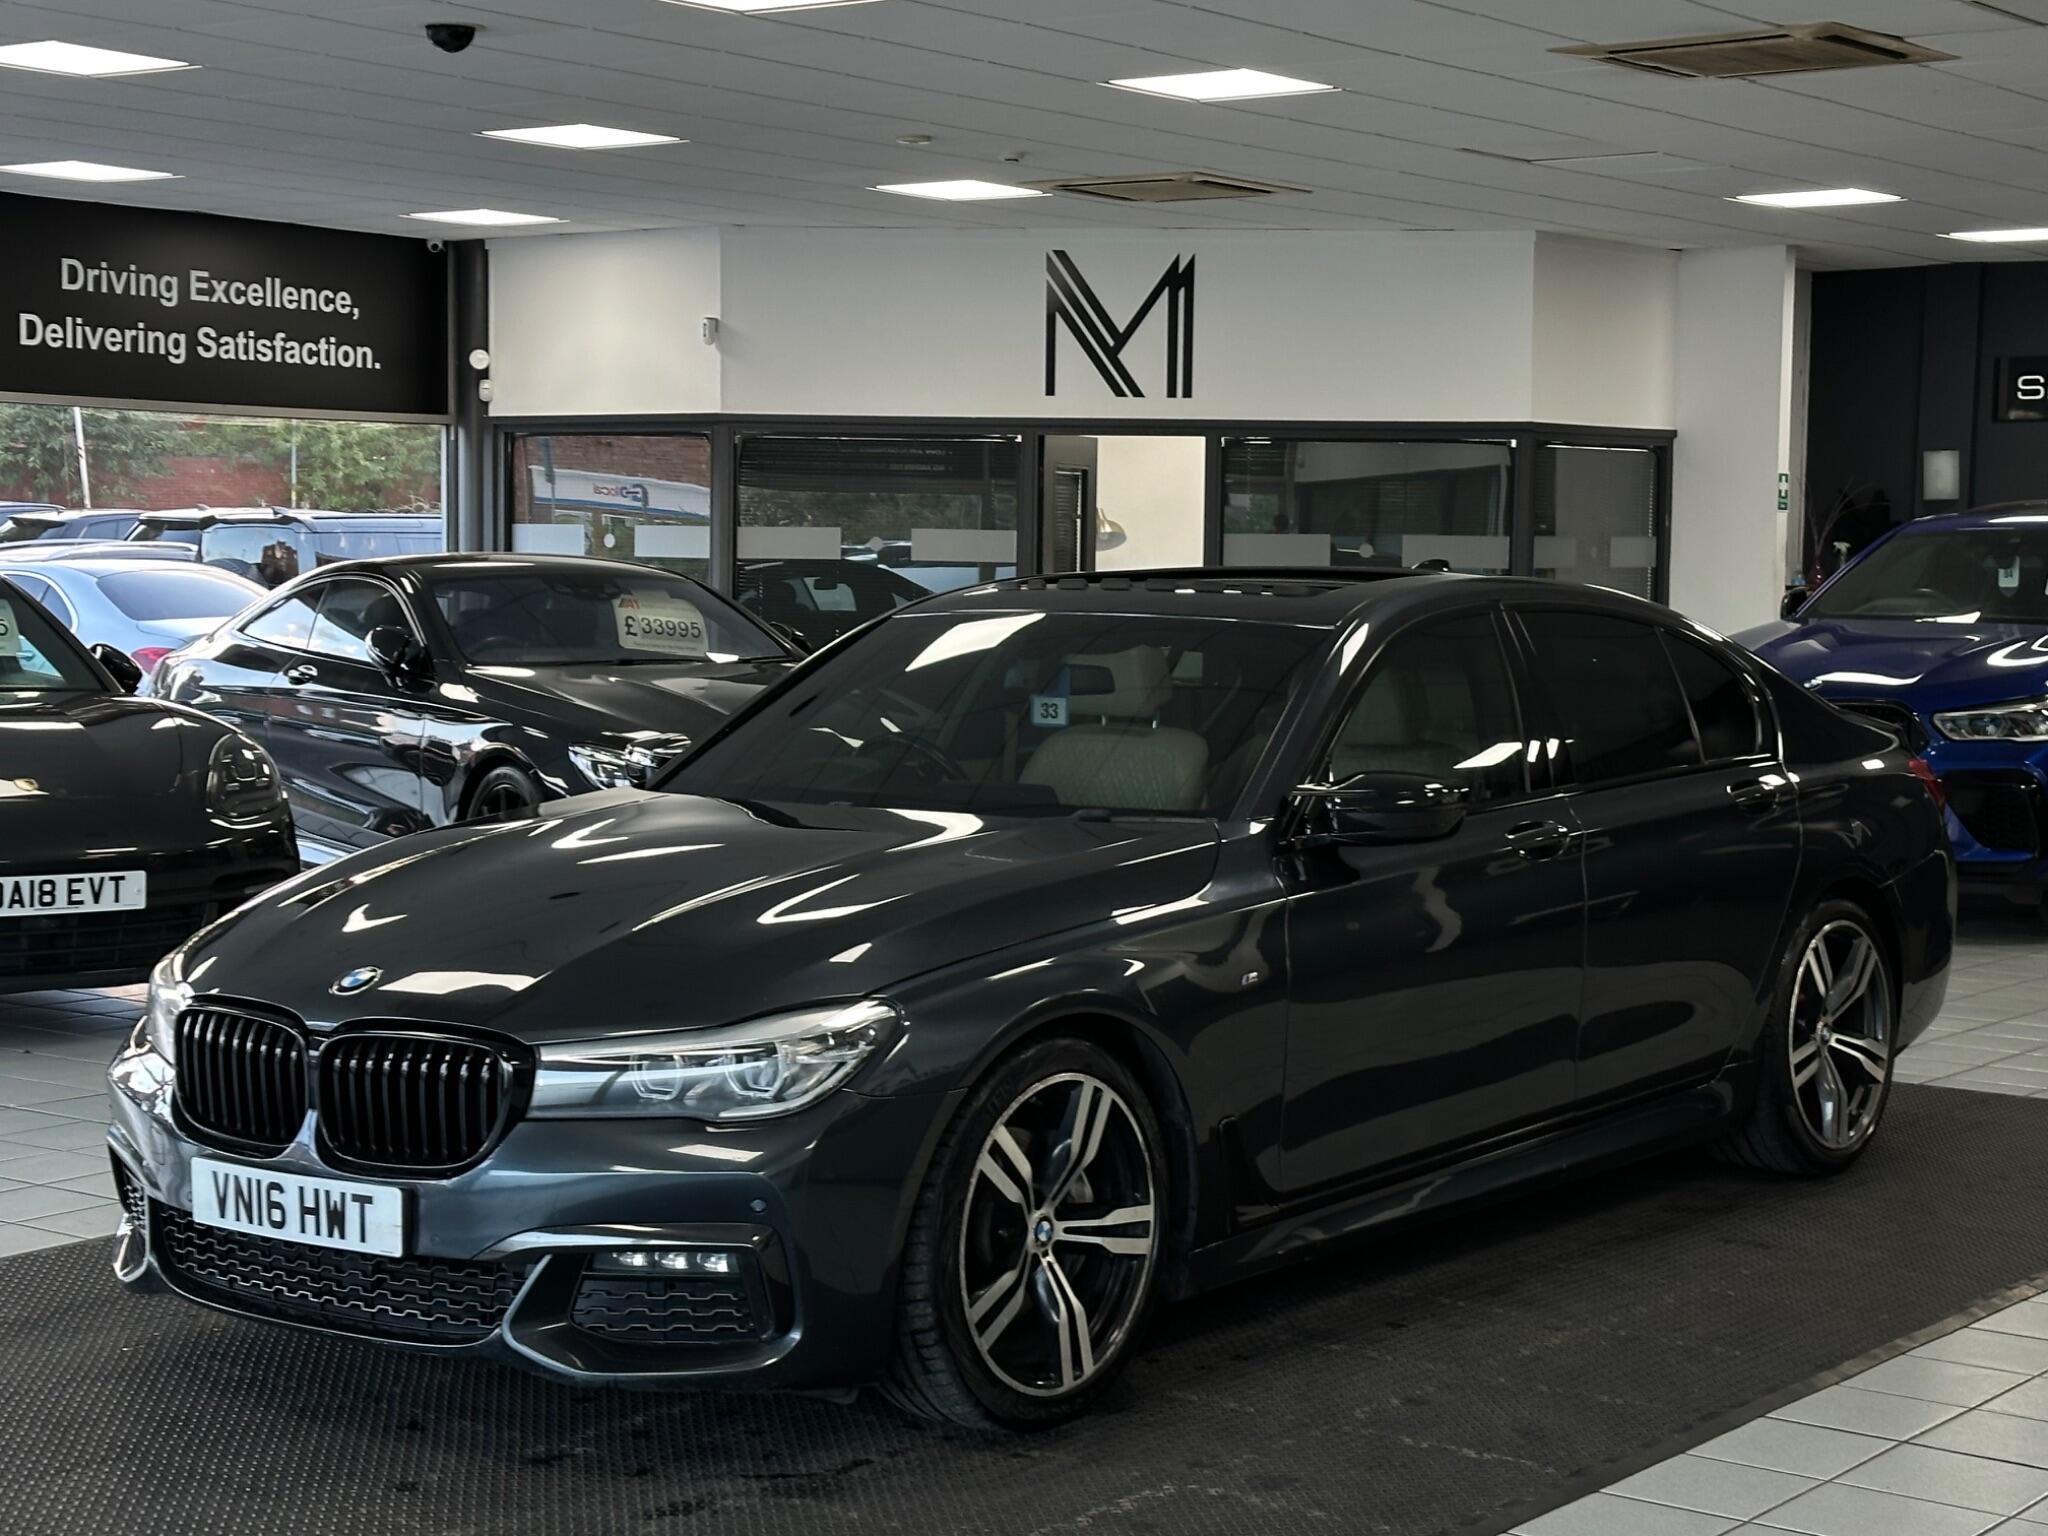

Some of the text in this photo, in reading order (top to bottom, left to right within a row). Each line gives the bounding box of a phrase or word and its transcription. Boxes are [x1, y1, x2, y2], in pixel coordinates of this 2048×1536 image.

[60, 257, 360, 320] Driving Excellence,
[18, 312, 382, 370] Delivering Satisfaction.
[624, 615, 702, 639] £33995
[1040, 702, 1059, 719] 33
[0, 875, 126, 909] A18 EVT
[212, 1170, 374, 1243] VN16 HWT
